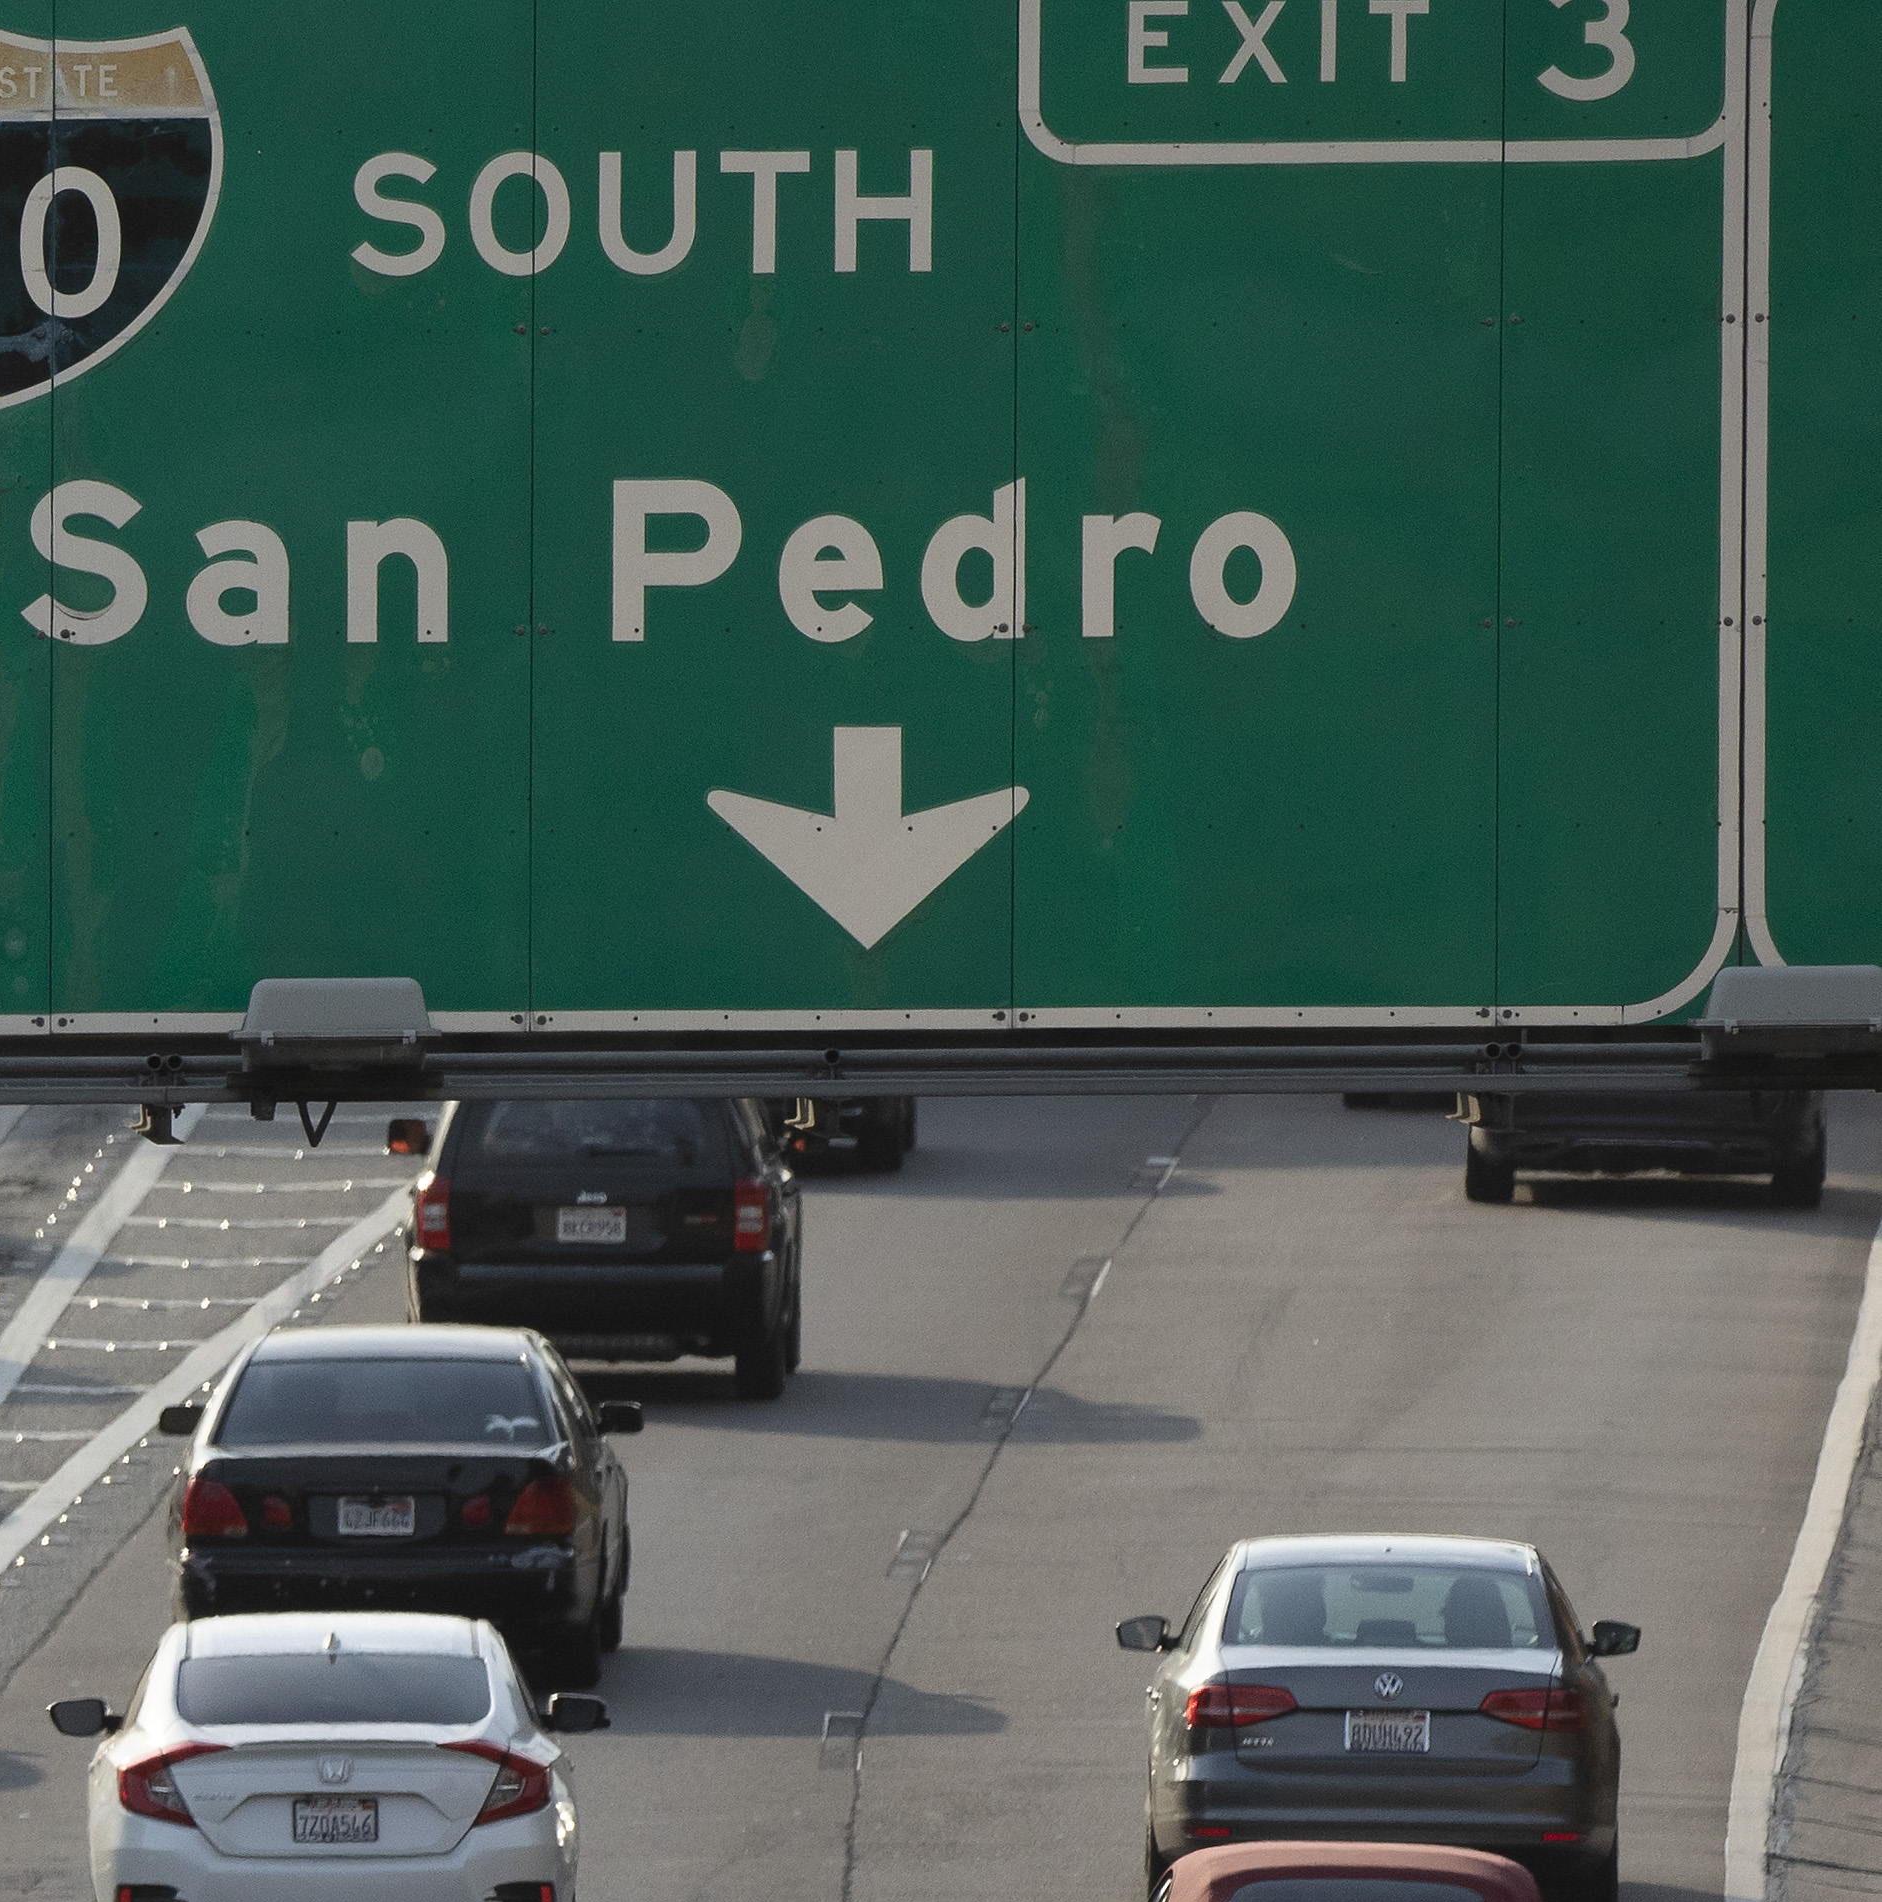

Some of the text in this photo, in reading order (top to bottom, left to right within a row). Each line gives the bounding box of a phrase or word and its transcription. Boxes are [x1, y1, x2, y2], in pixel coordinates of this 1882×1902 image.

[1129, 0, 1634, 101] EXIT 3
[352, 150, 933, 276] SOUTH
[22, 478, 1297, 645] San Pedro
